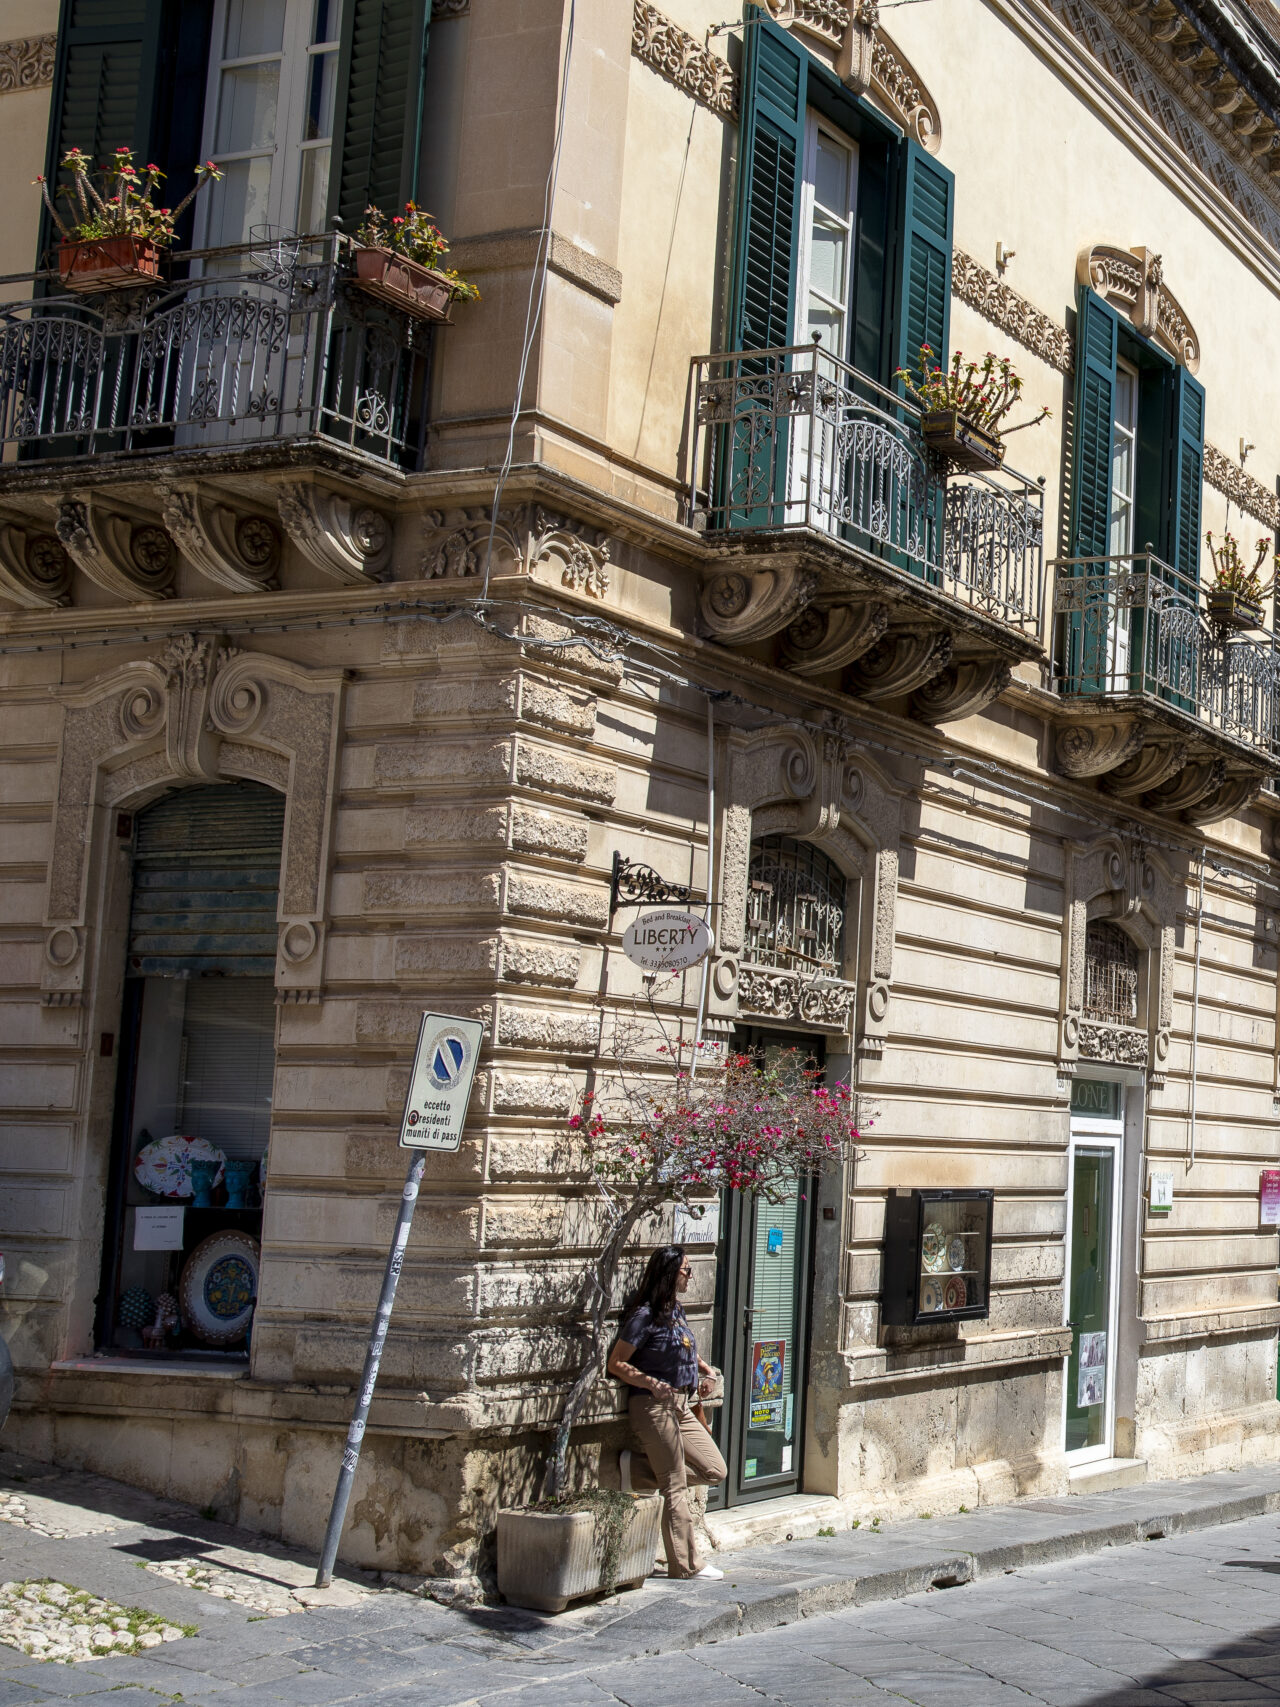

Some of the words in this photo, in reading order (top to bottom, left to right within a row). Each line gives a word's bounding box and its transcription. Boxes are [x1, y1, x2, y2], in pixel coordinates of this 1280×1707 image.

[642, 917, 653, 925] Bed
[666, 912, 691, 924] Breakfast
[634, 928, 698, 945] LIBERTY
[424, 1100, 451, 1111] eccetto
[418, 1114, 451, 1126] residenti
[405, 1128, 430, 1138] muniti
[432, 1129, 440, 1140] di
[441, 1132, 457, 1143] pass
